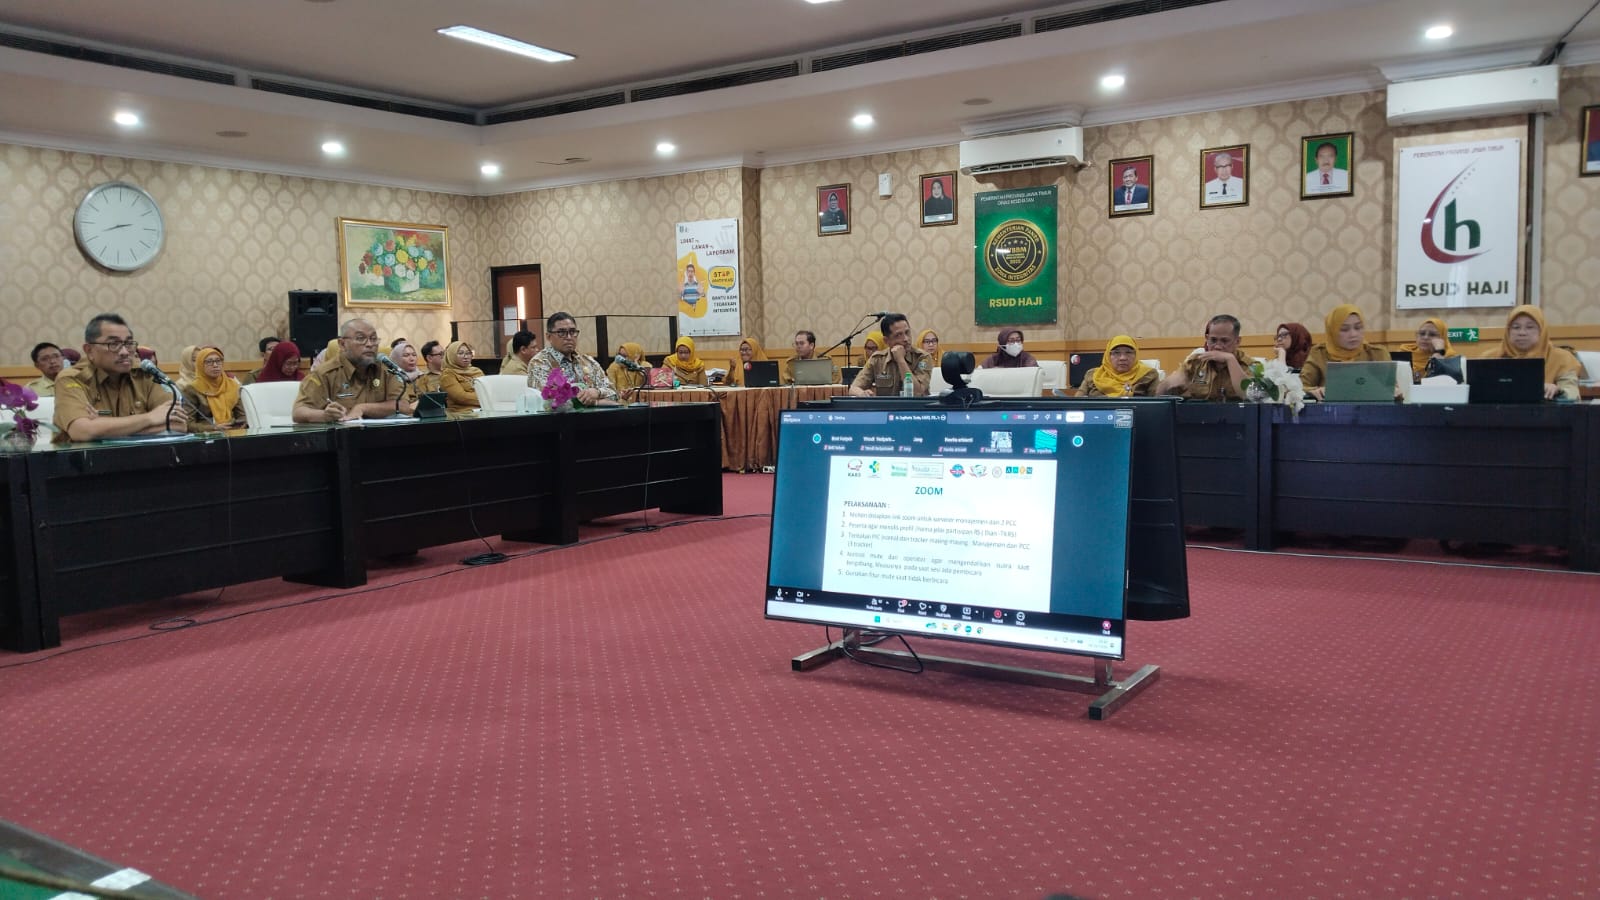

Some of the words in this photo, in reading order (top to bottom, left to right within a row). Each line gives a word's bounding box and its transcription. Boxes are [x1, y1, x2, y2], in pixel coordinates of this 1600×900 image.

[1405, 283, 1460, 297] RSUD
[1467, 281, 1509, 295] HAJI
[989, 298, 1016, 308] RSUD
[1018, 296, 1042, 307] HAJI
[915, 486, 943, 495] ZOOM
